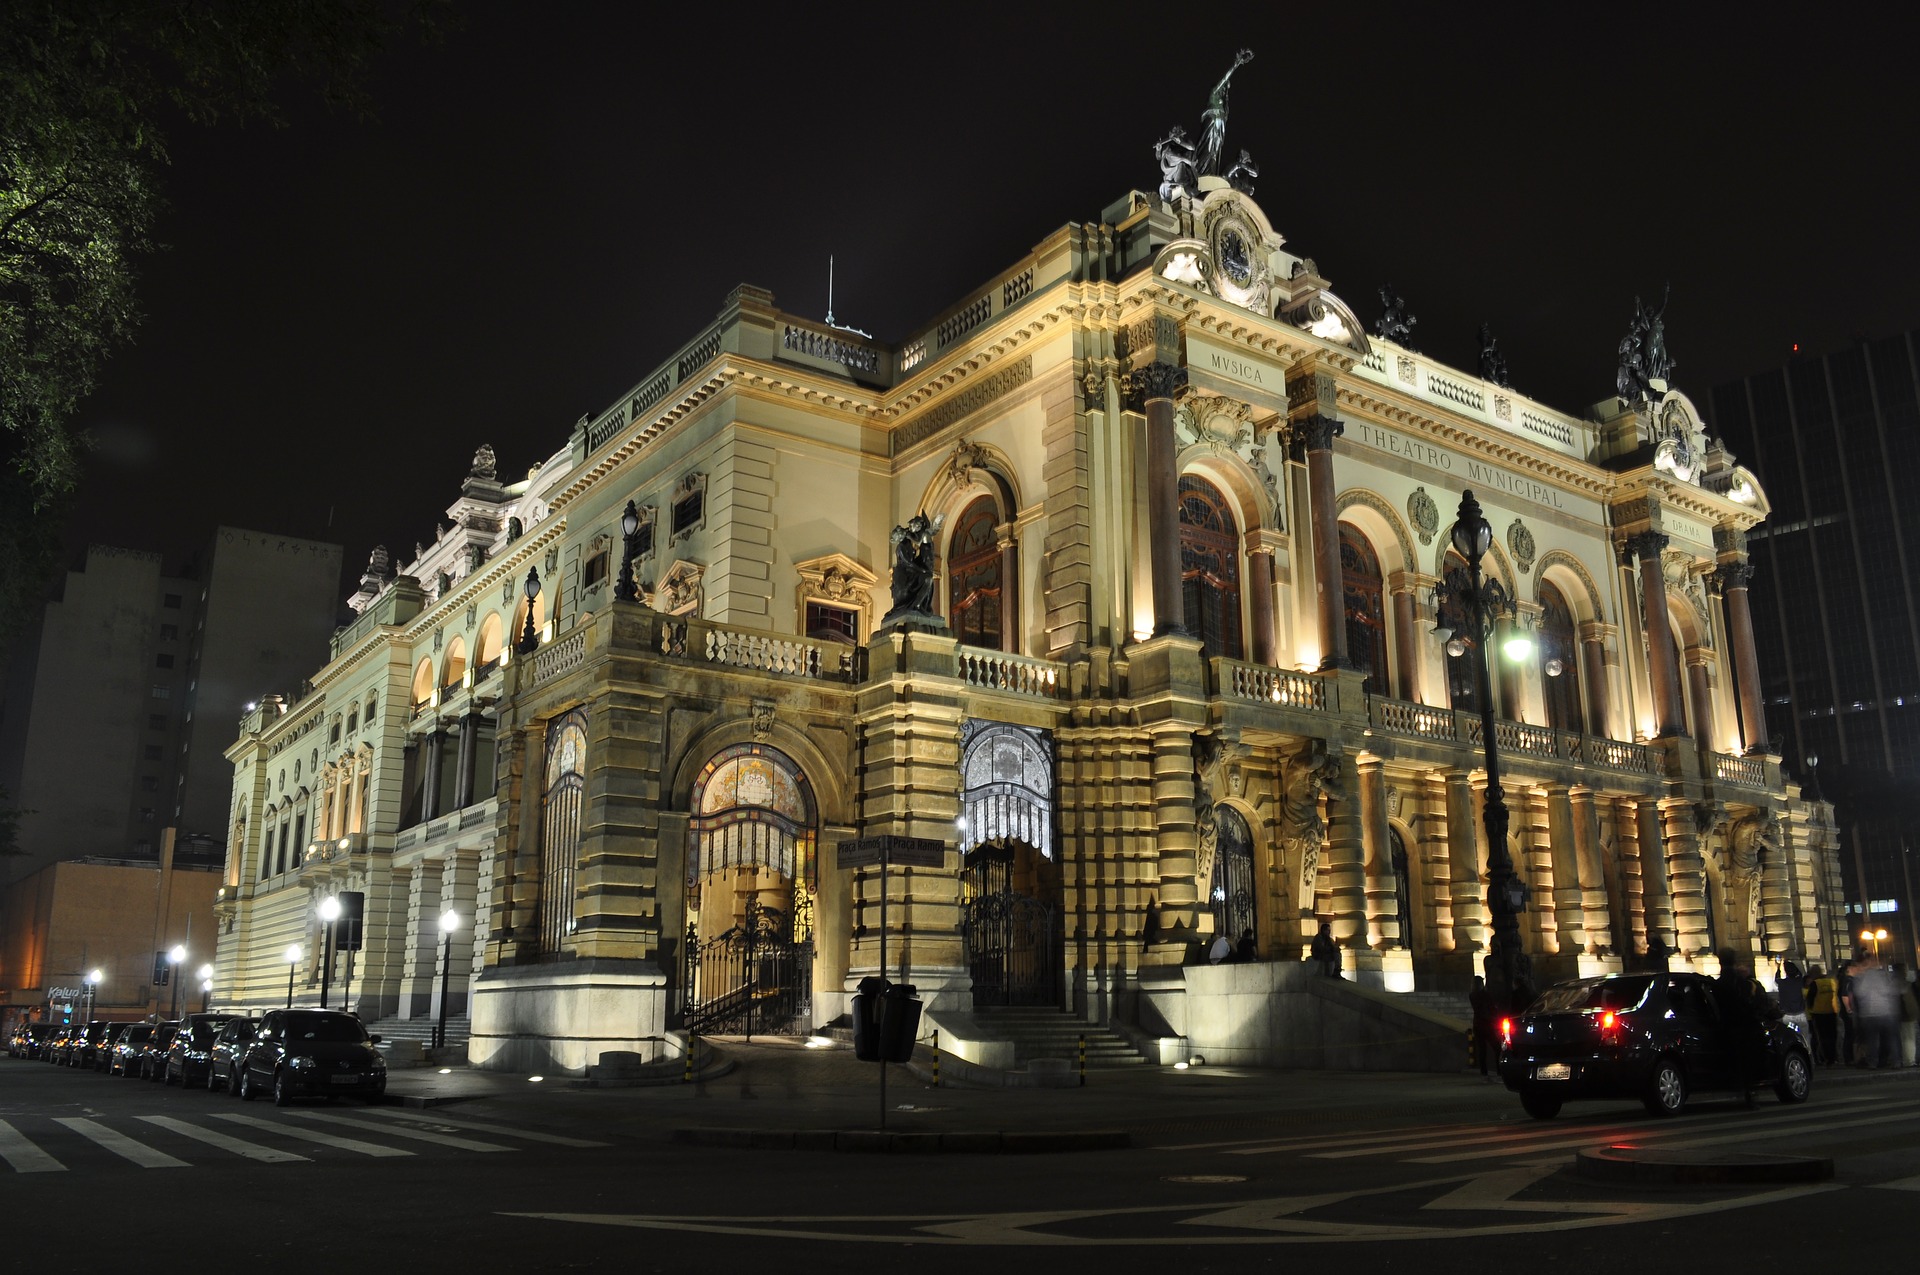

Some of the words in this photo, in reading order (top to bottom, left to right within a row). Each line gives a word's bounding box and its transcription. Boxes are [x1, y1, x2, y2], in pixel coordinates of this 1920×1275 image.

[1211, 353, 1263, 383] MVSICA
[1360, 424, 1451, 470] THEATRO
[1468, 461, 1563, 508] MVNICIPAL
[1673, 520, 1700, 538] DRAMA
[838, 843, 856, 855] Praça
[858, 839, 880, 851] Ramos
[893, 837, 915, 852] Praça
[917, 839, 944, 852] Ramos
